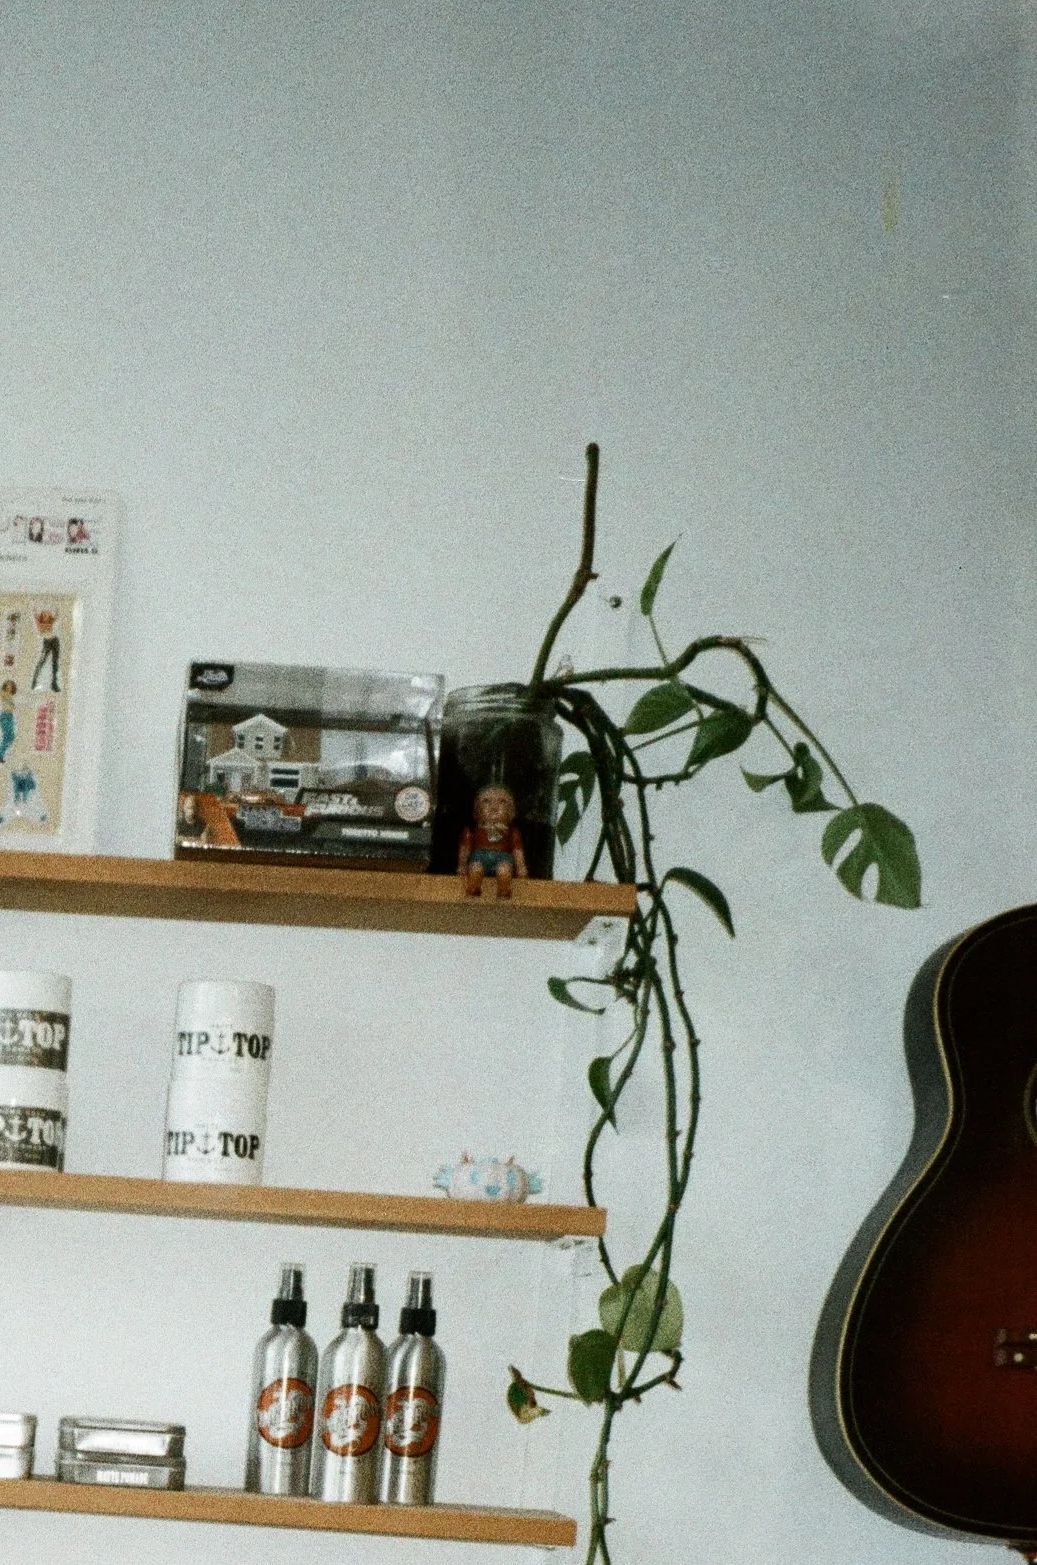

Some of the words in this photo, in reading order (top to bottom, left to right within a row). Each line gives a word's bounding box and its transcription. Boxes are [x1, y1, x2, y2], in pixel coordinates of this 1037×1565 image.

[18, 1019, 66, 1050] TOP
[177, 1030, 210, 1056] TIP
[233, 1031, 272, 1061] TOP
[167, 1131, 195, 1156] TIP
[218, 1131, 260, 1161] TOP
